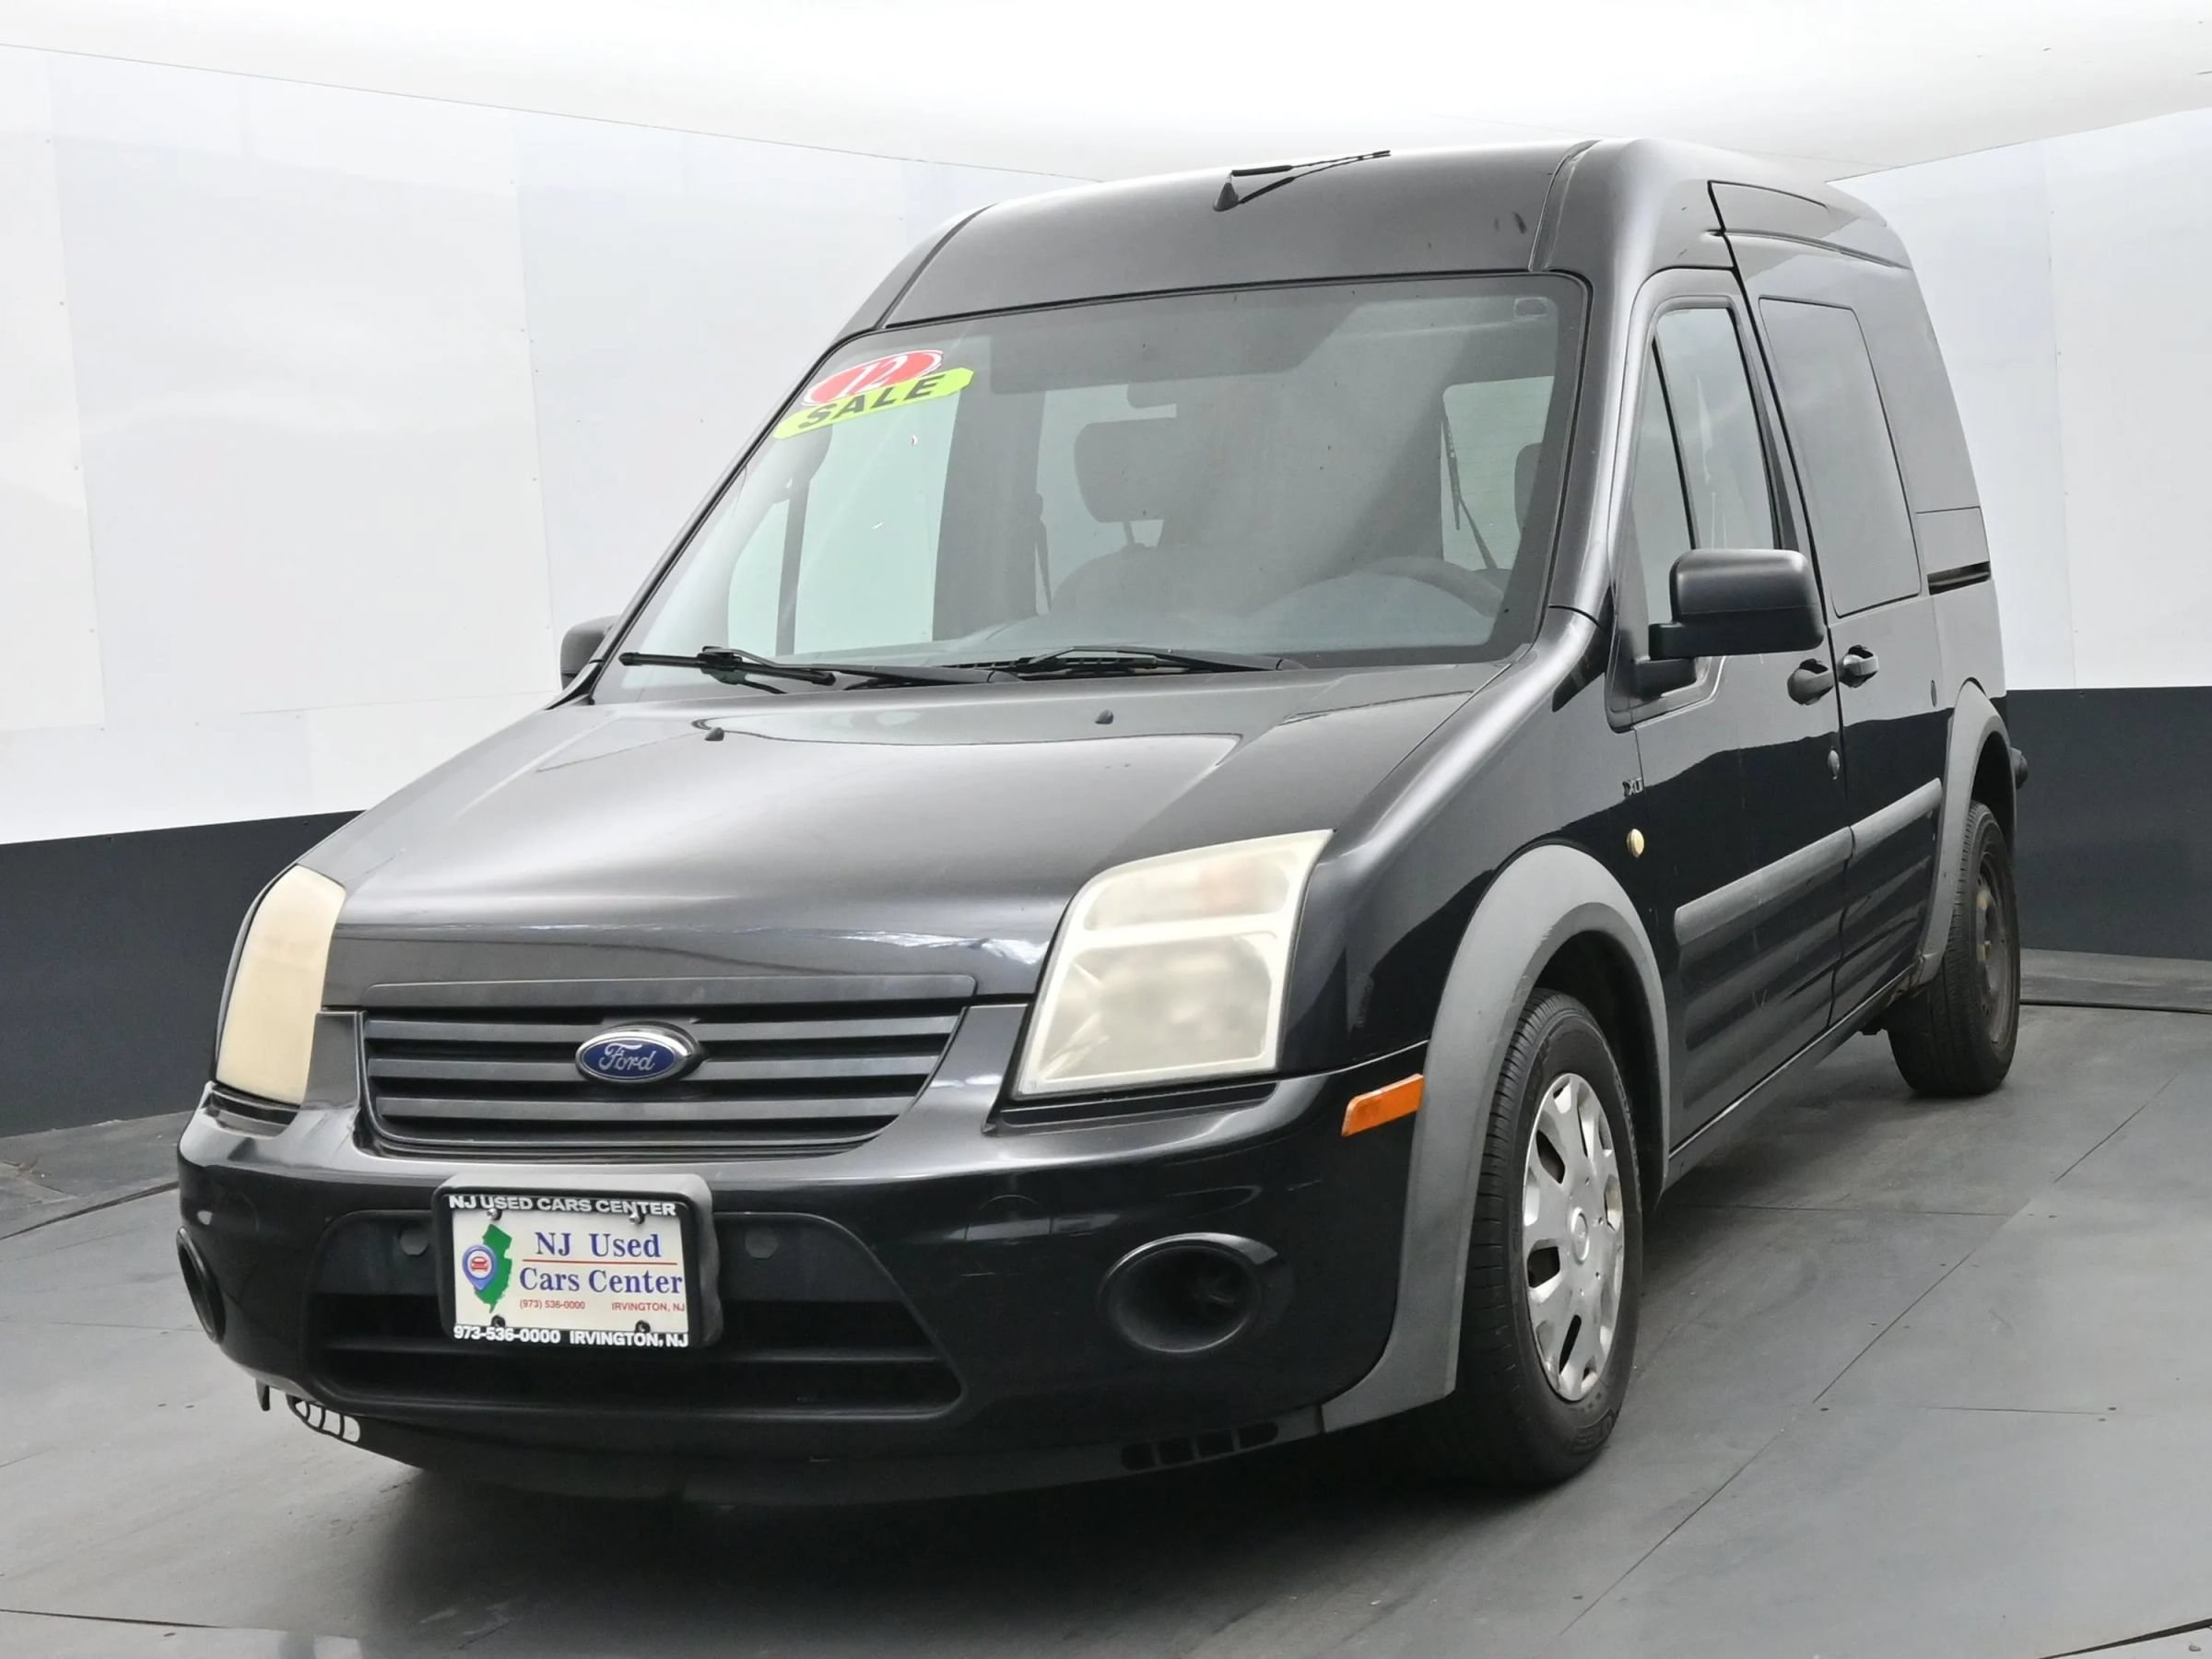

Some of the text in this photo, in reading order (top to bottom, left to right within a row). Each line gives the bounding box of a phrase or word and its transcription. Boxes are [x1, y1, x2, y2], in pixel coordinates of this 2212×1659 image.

[798, 374, 947, 429] SALE
[599, 1042, 657, 1071] Ford
[449, 1195, 677, 1216] NJ USED CARS CENTER
[535, 1231, 662, 1257] NJ Used
[519, 1266, 684, 1294] Cars Center
[519, 1299, 586, 1310] (973) 536-0000
[611, 1301, 686, 1312] IRVINGTON, NJ
[453, 1324, 561, 1344] 973-536-0000
[569, 1330, 689, 1348] IRVINGTON, NJ
